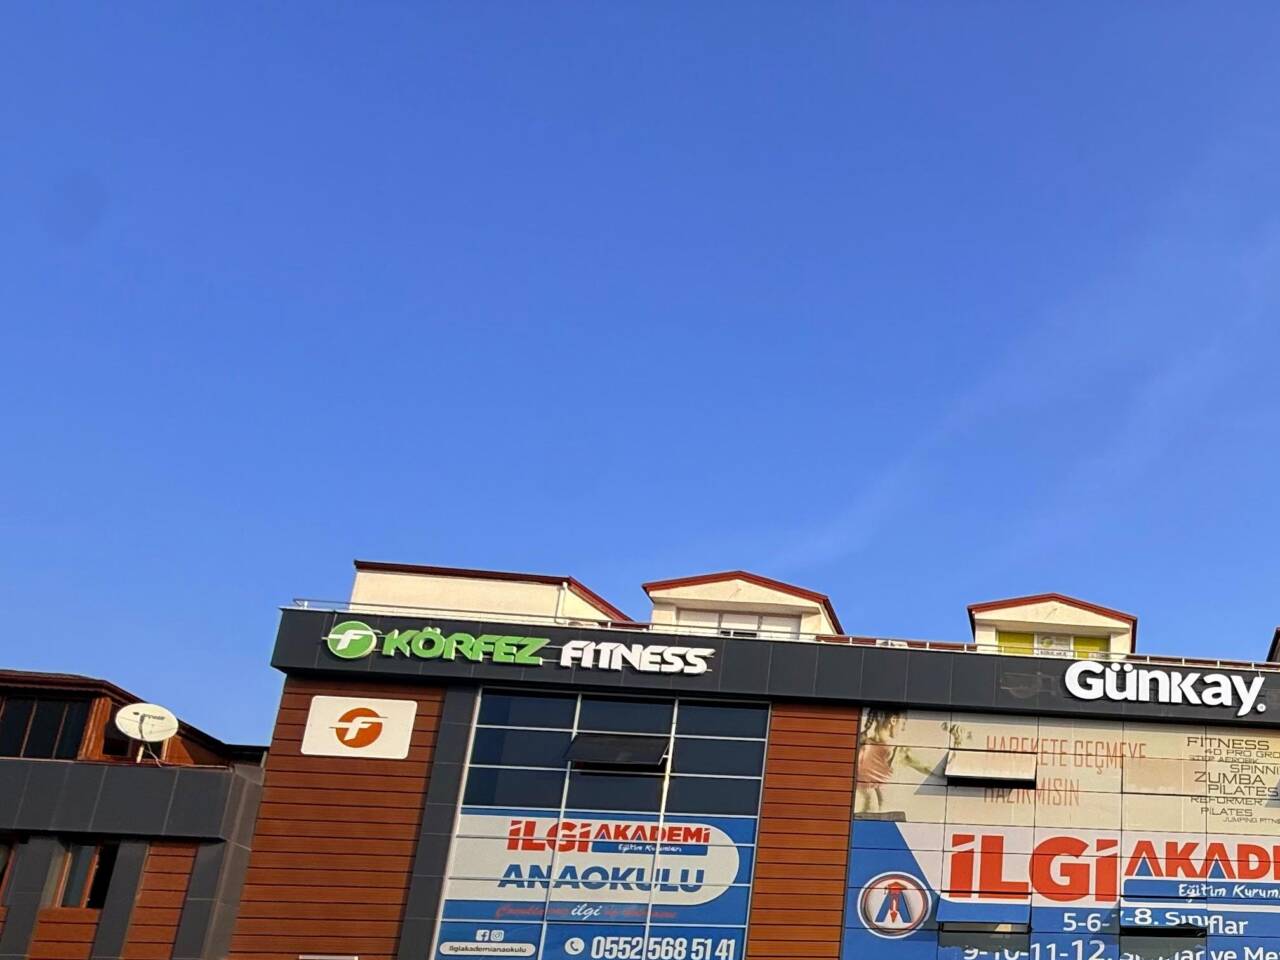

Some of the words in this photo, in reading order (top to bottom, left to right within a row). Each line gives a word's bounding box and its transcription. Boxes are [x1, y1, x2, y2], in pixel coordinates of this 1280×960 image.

[381, 626, 551, 667] KÖRFEZ
[1226, 748, 1252, 758] PRO
[1194, 770, 1266, 786] ZUMBA
[497, 863, 705, 893] ANAOKULU
[1178, 883, 1227, 903] Eğitim
[570, 903, 602, 921] ilgi
[591, 936, 643, 960] 0552
[647, 937, 687, 960] 568
[690, 938, 712, 960] 51
[714, 938, 736, 960] 41
